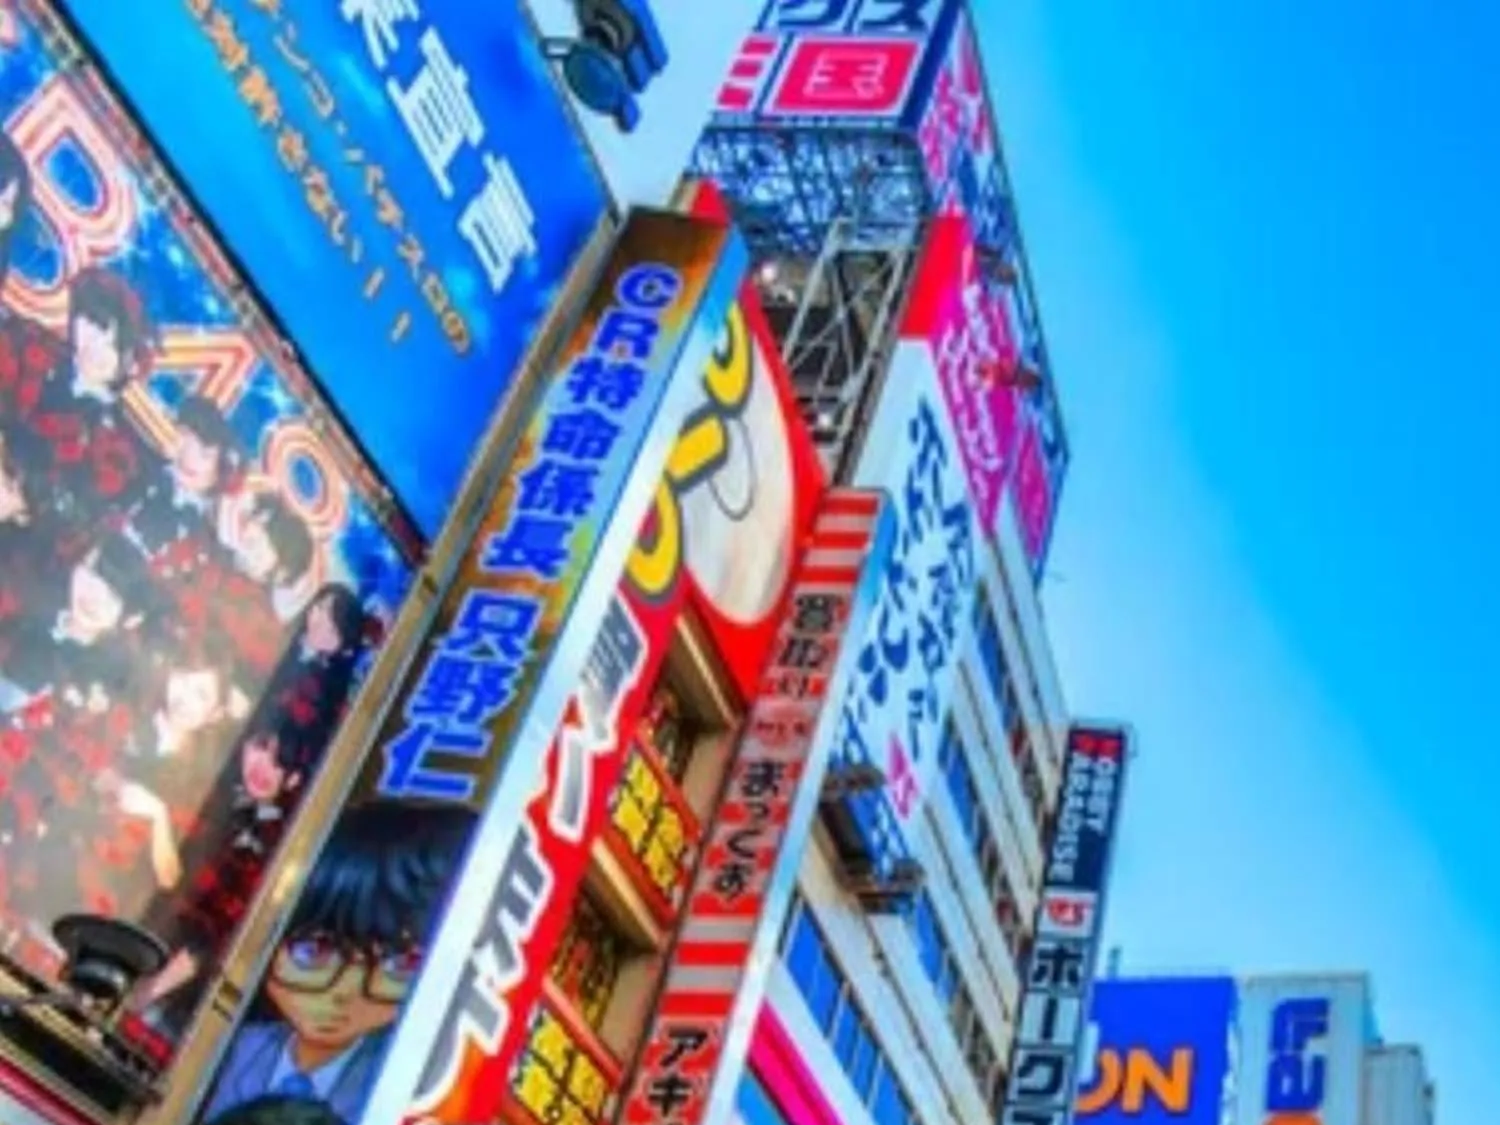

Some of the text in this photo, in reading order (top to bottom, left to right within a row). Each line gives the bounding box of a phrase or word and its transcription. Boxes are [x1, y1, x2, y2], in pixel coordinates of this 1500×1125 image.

[484, 262, 682, 582] CR特命係長
[377, 590, 541, 800] 只野仁
